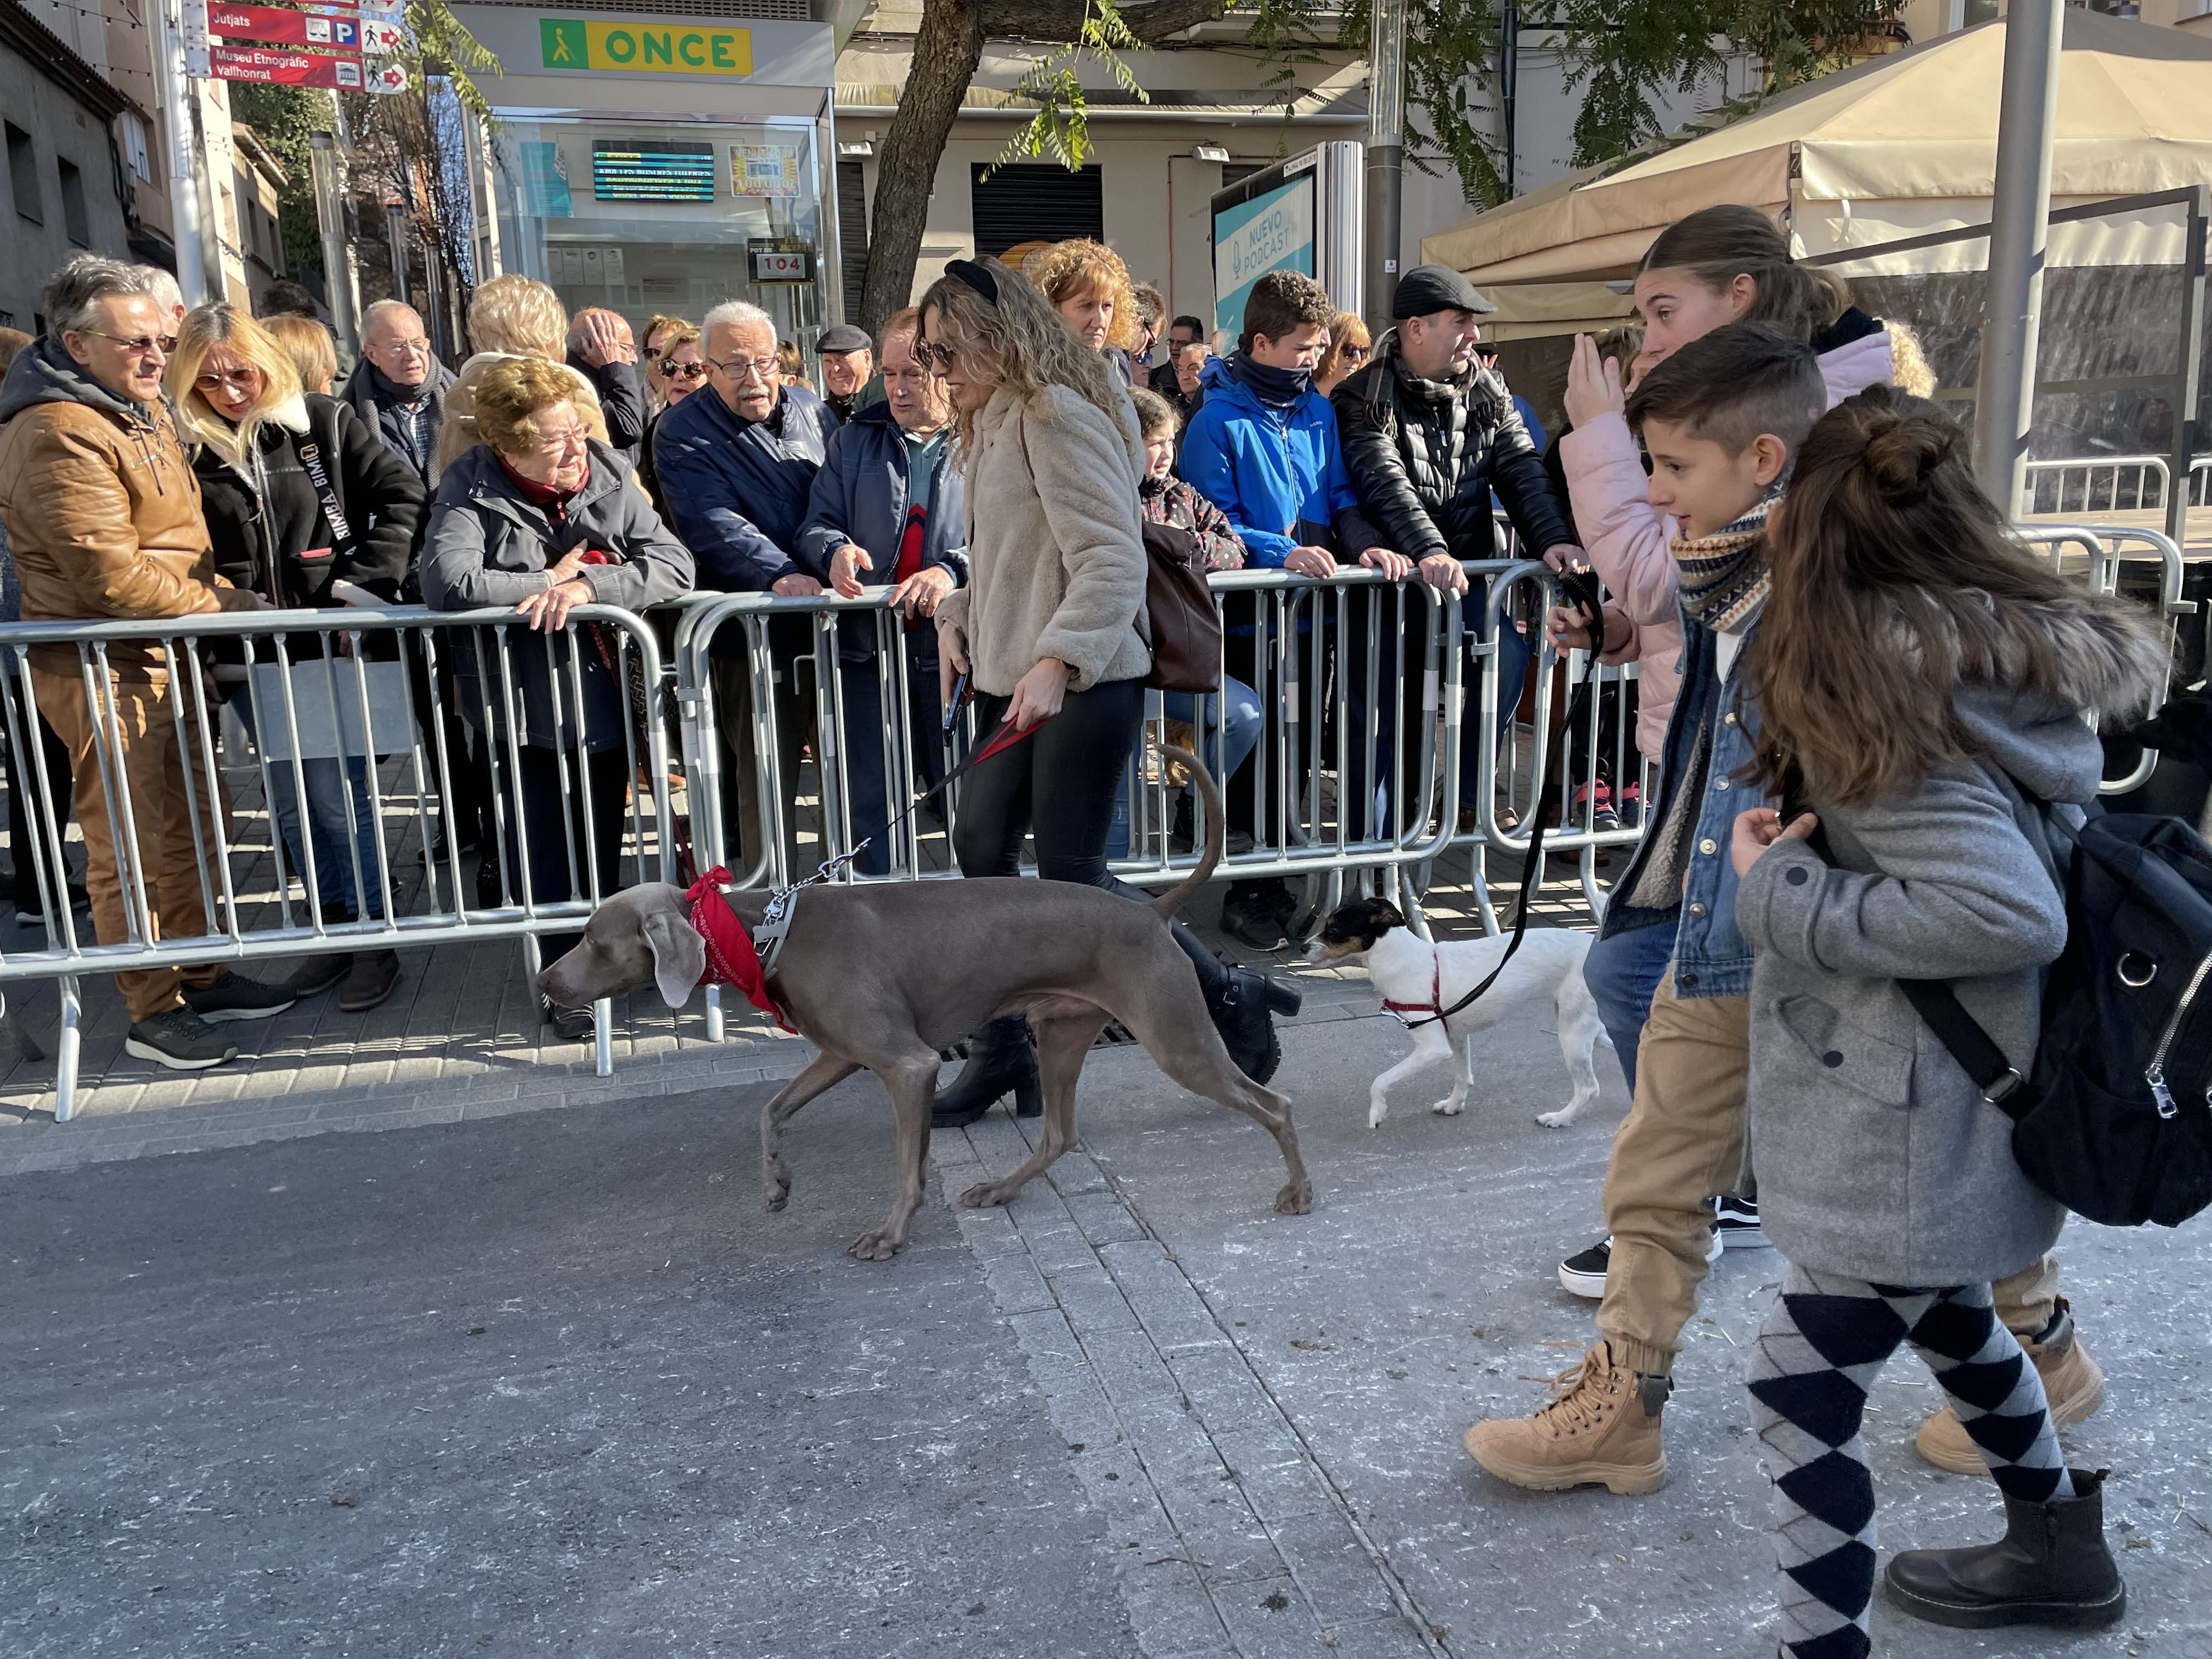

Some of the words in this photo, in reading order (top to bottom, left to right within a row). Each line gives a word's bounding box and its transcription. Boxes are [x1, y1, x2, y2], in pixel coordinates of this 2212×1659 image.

[214, 12, 251, 27] Jutjats
[216, 49, 252, 63] Museu
[254, 53, 308, 68] Etnogràfic
[606, 30, 736, 67] ONCE
[217, 64, 271, 80] Vallhonrat
[1250, 210, 1282, 247] NUEVO
[764, 257, 800, 270] 104
[1244, 227, 1289, 274] PODCAST
[321, 492, 351, 541] BIMBA
